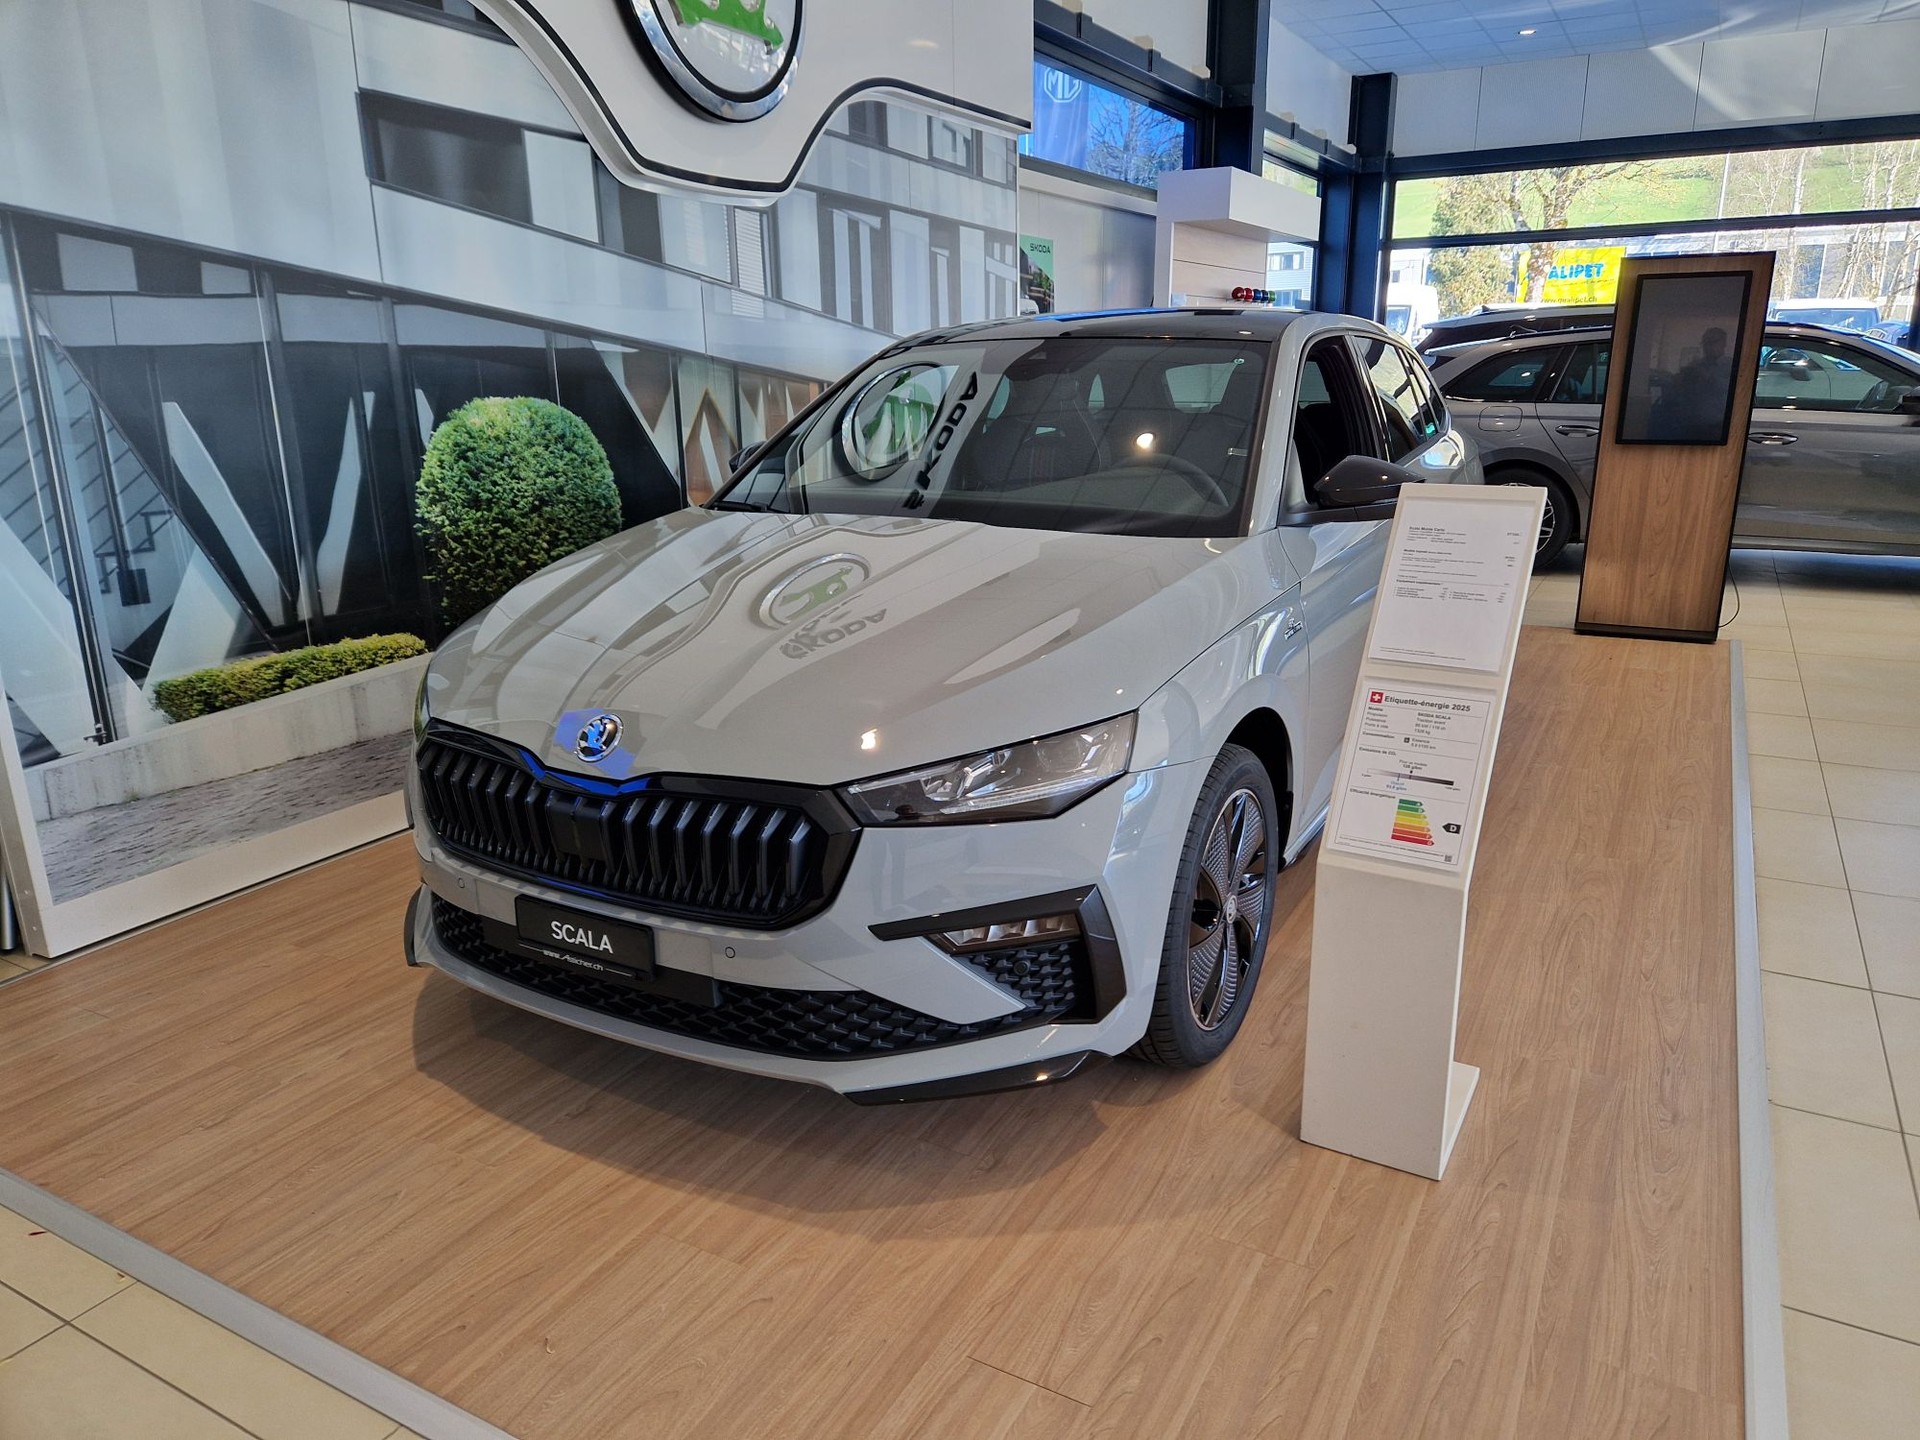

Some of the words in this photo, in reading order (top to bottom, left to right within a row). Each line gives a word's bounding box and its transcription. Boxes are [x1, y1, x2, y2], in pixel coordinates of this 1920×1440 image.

[1384, 695, 1450, 710] Etiquette-énergie
[1452, 703, 1471, 712] 2025
[551, 921, 614, 954] SCALA
